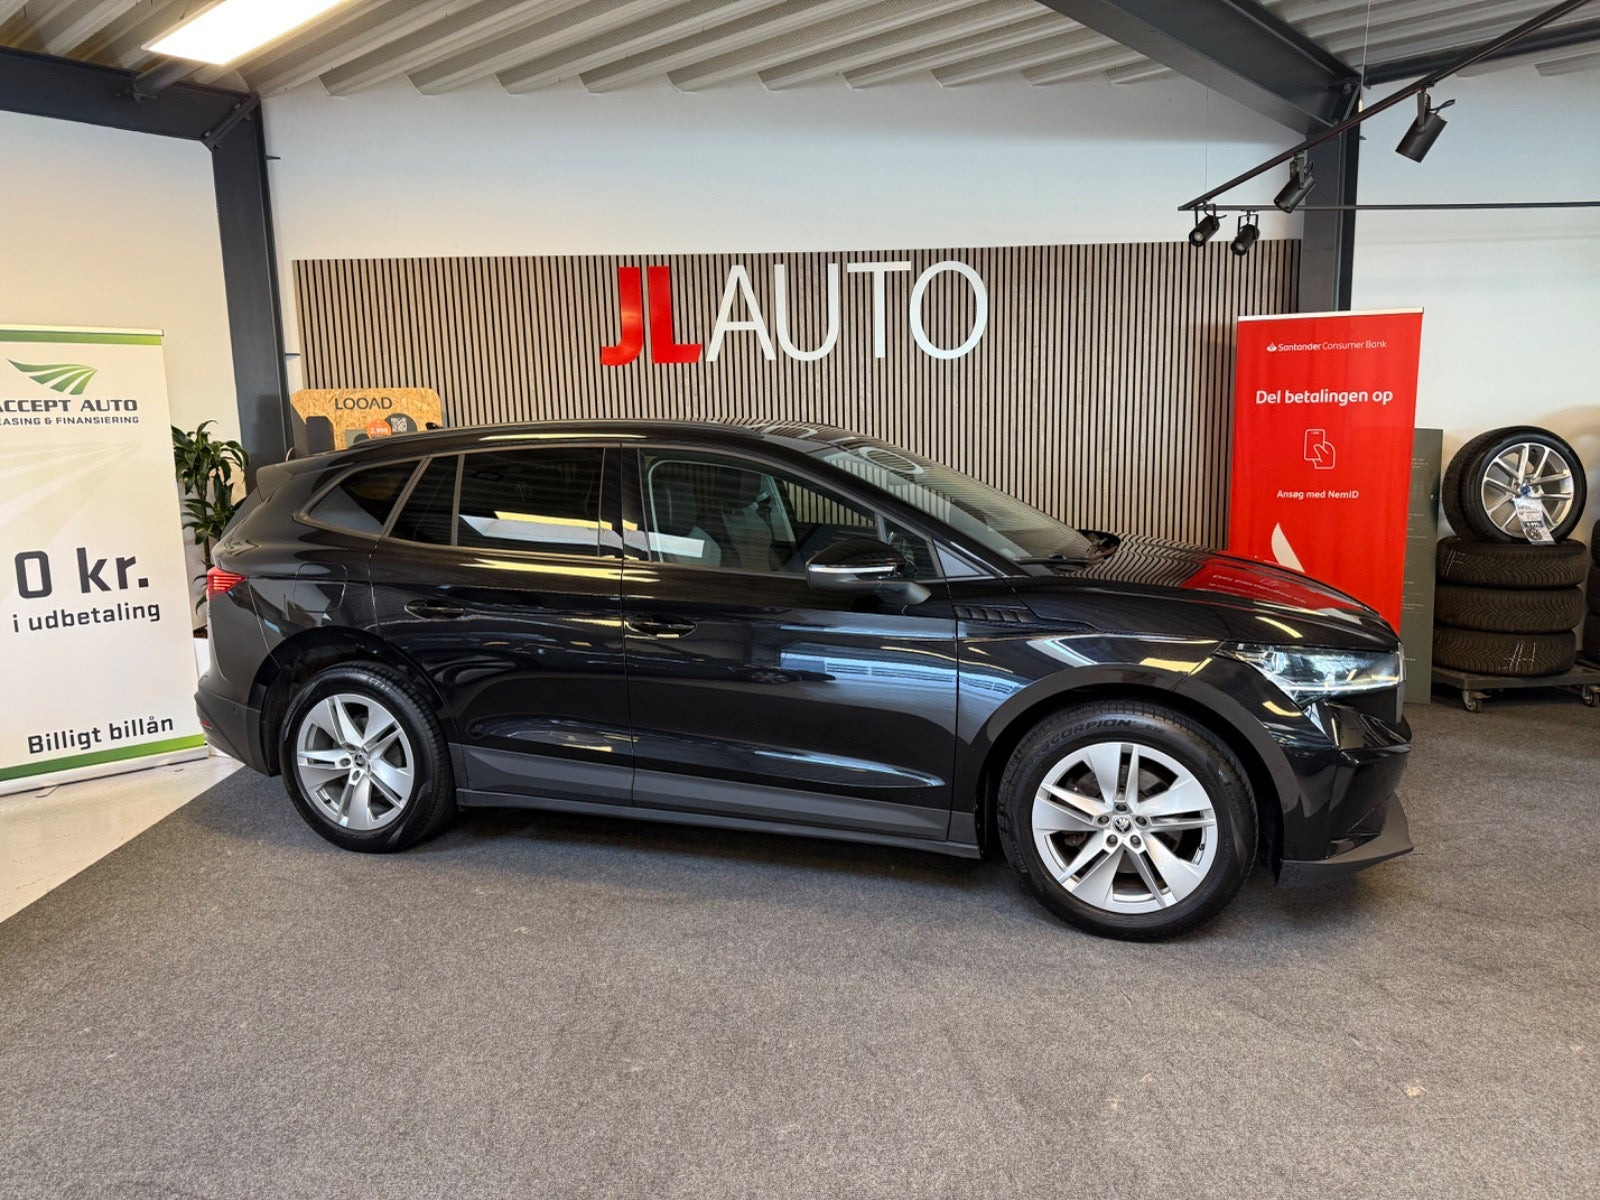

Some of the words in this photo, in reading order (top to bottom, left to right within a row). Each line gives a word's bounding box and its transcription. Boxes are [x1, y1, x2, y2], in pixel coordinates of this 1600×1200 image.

[1278, 342, 1321, 352] Santander
[1322, 340, 1364, 351] Consumer
[1365, 340, 1387, 349] Bank
[335, 397, 393, 410] LOOAD
[1256, 391, 1281, 405] Del
[1285, 388, 1368, 406] betalingen
[1372, 391, 1393, 405] op
[0, 399, 72, 413] CCEPT
[80, 399, 138, 412] AUTO
[44, 417, 53, 425] &
[56, 416, 140, 425] FINANSIERING
[1277, 490, 1304, 500] Ansøg
[1306, 490, 1326, 499] med
[1328, 490, 1359, 499] NemID
[14, 550, 53, 600] 0
[76, 547, 150, 594] kr.
[12, 614, 20, 633] i
[28, 602, 161, 632] udbetaling
[27, 726, 102, 755] Billigt
[109, 715, 174, 741] billån
